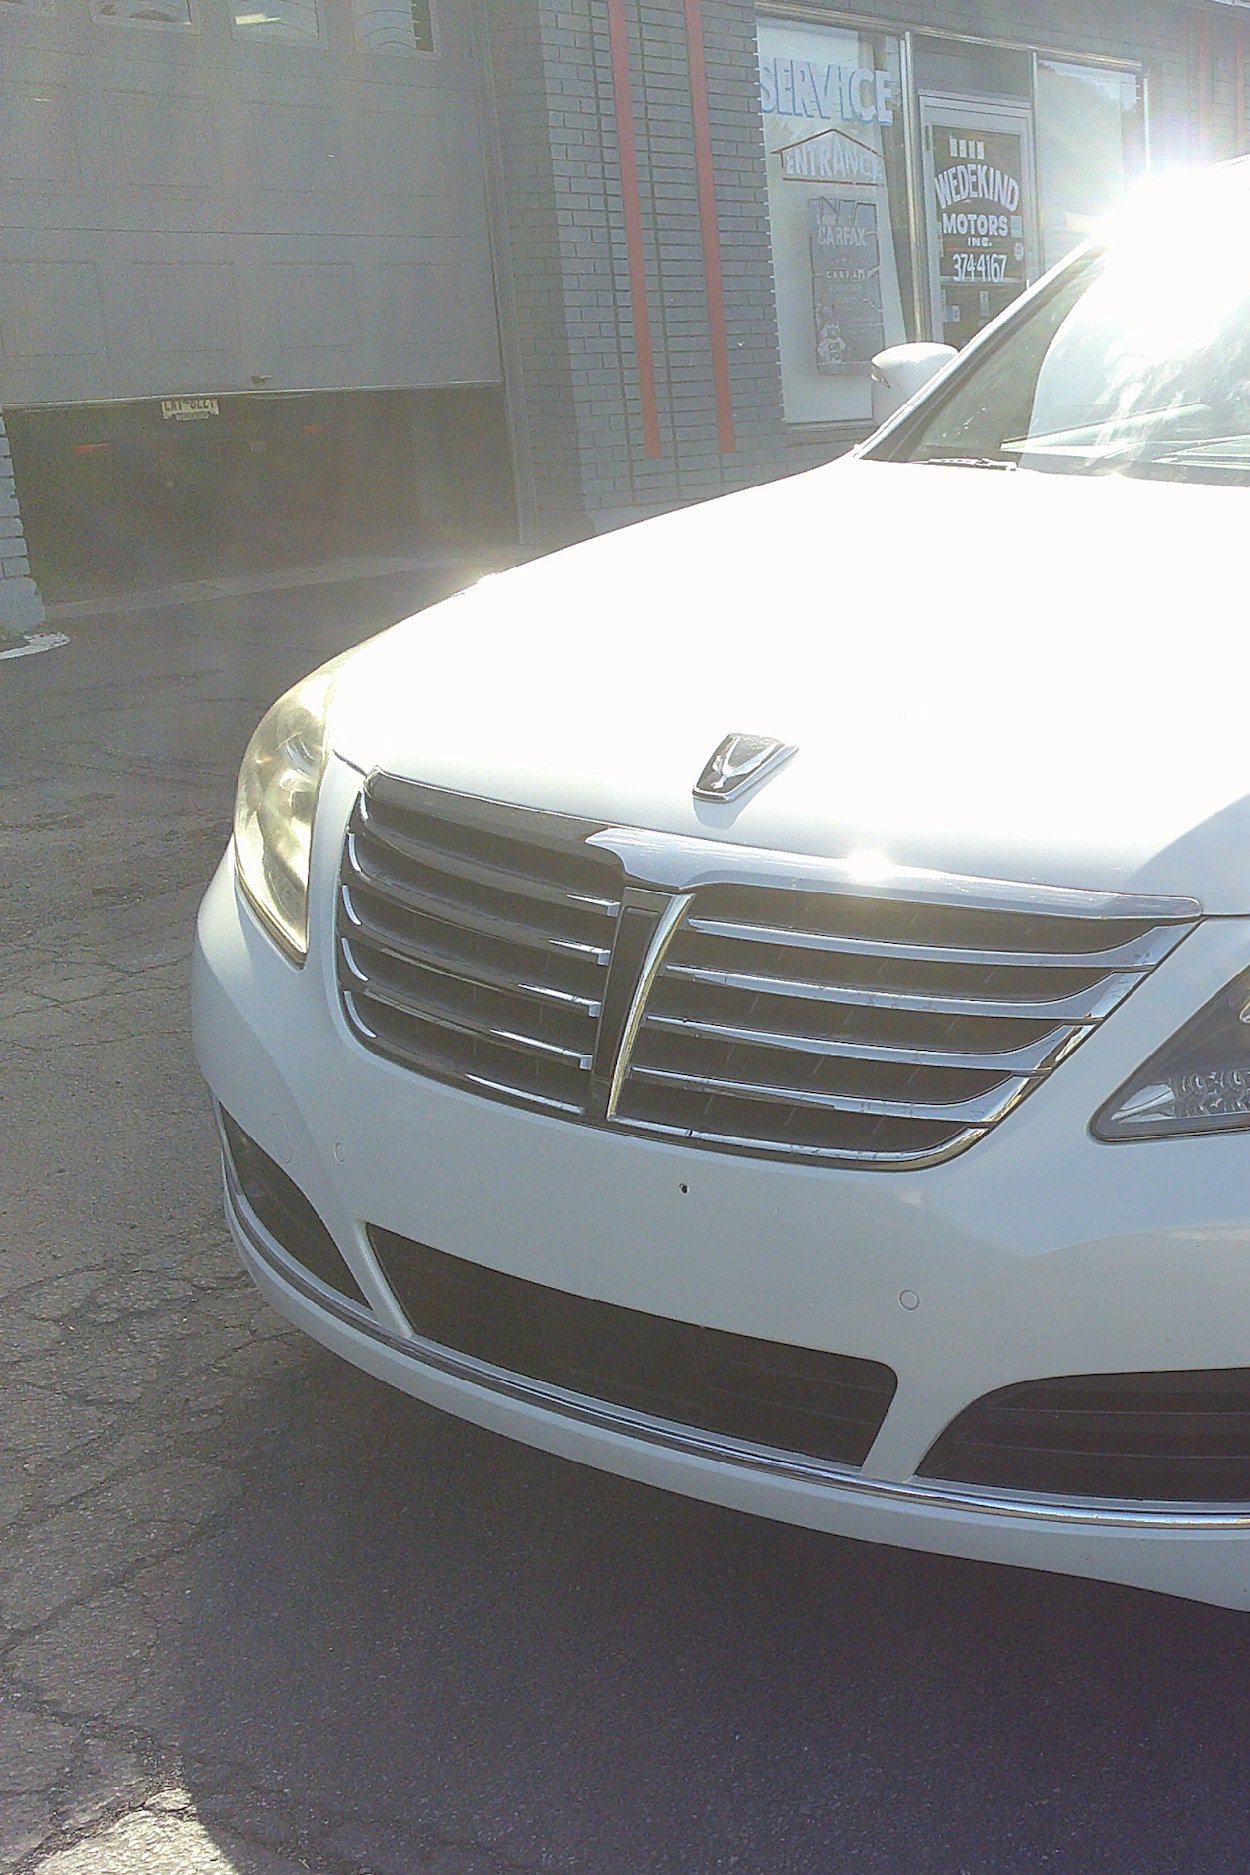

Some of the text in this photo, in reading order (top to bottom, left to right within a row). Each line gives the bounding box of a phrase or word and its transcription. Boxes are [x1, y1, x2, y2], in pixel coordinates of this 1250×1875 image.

[761, 58, 893, 126] SERVICE
[785, 134, 884, 180] ENTRANCE
[934, 164, 1019, 212] WEDEKIND
[942, 212, 1008, 237] MOTORS
